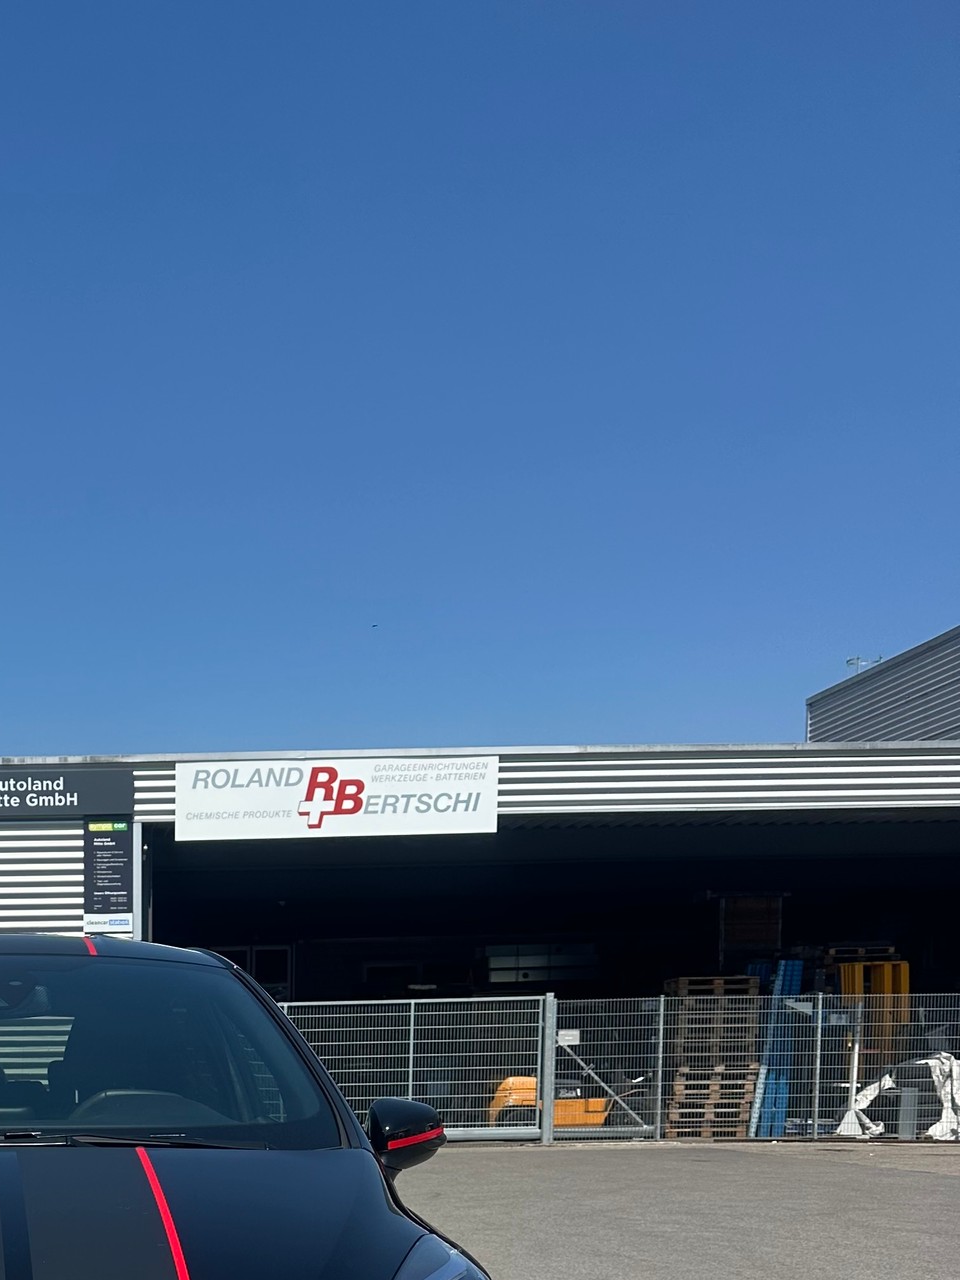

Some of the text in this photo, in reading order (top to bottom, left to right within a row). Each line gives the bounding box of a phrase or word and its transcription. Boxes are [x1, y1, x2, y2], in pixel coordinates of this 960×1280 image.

[374, 762, 489, 772] GARAGEEINRICHTUNGEN
[192, 767, 304, 790] ROLAND
[371, 772, 486, 783] WERKZEUGE BATTERIEN
[25, 792, 78, 807] GmbH
[185, 809, 293, 821] CHEMISCHE PRODUKTE
